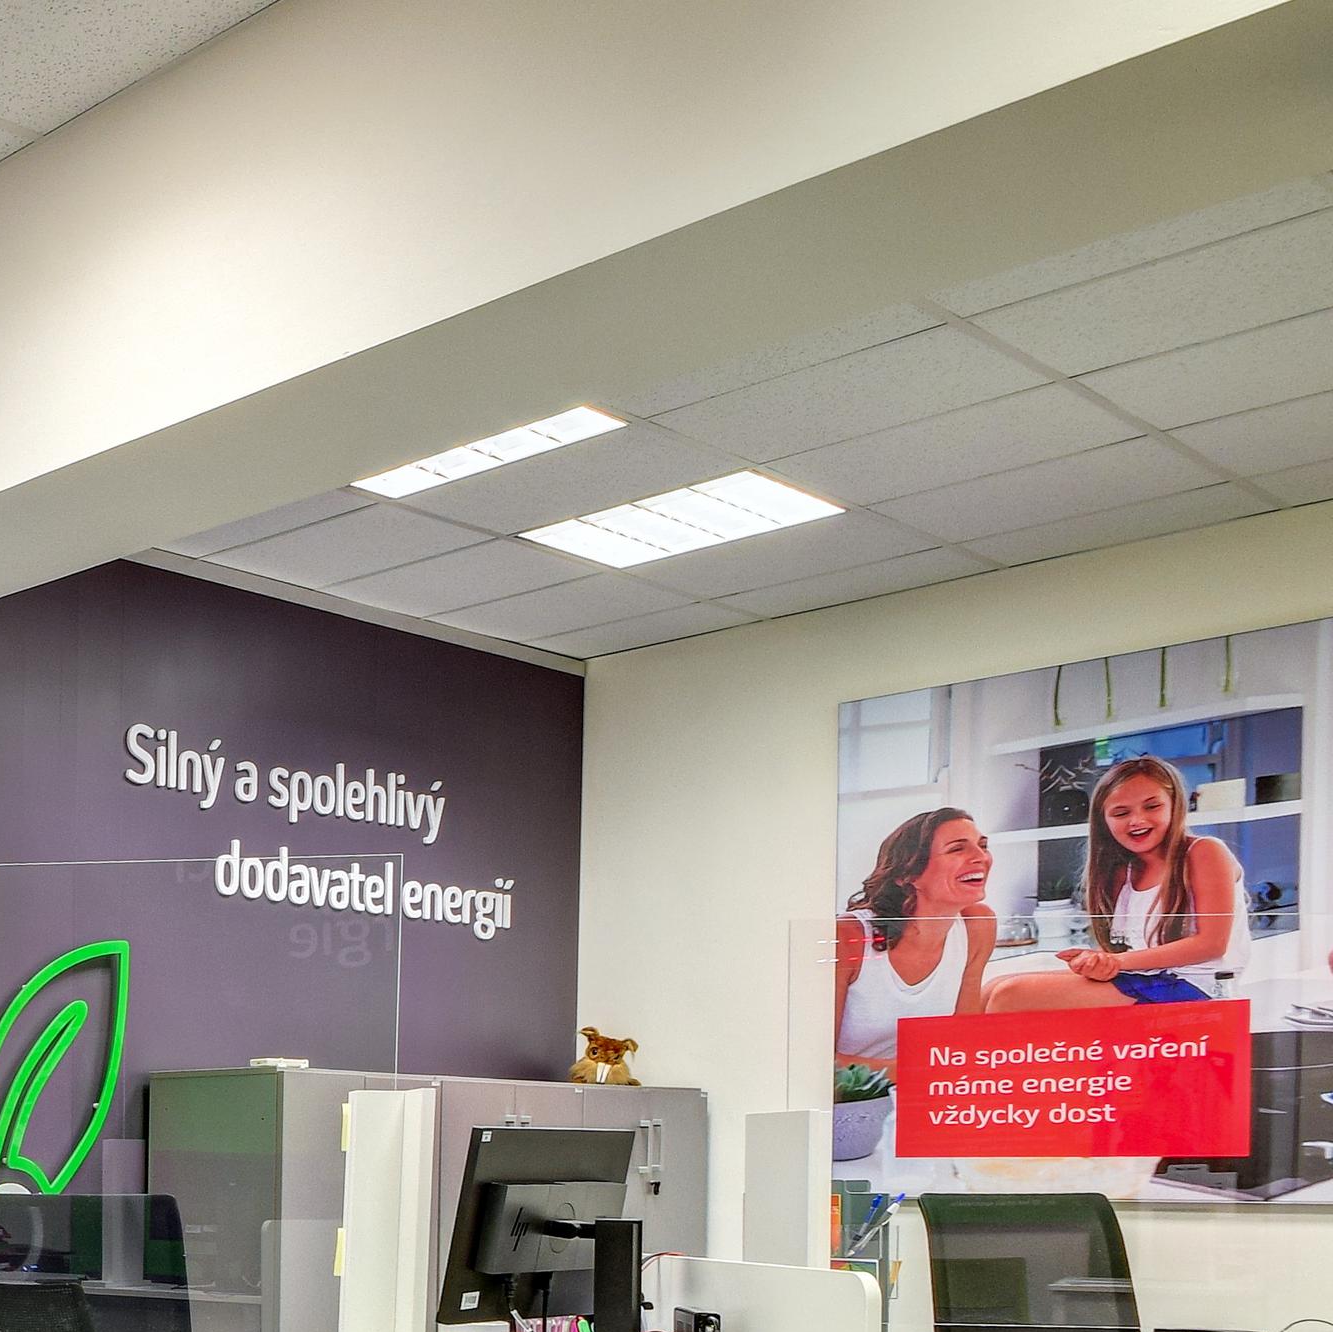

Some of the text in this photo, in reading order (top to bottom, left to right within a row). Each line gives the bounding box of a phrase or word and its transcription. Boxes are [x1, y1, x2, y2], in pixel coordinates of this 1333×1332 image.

[125, 723, 445, 845] Silný a spolehlivý
[214, 839, 394, 915] dodavatel
[402, 878, 514, 940] energií
[929, 1035, 1210, 1069] Na společné vaření
[929, 1071, 1132, 1097] máme energie
[929, 1103, 1116, 1129] vždycky dost
